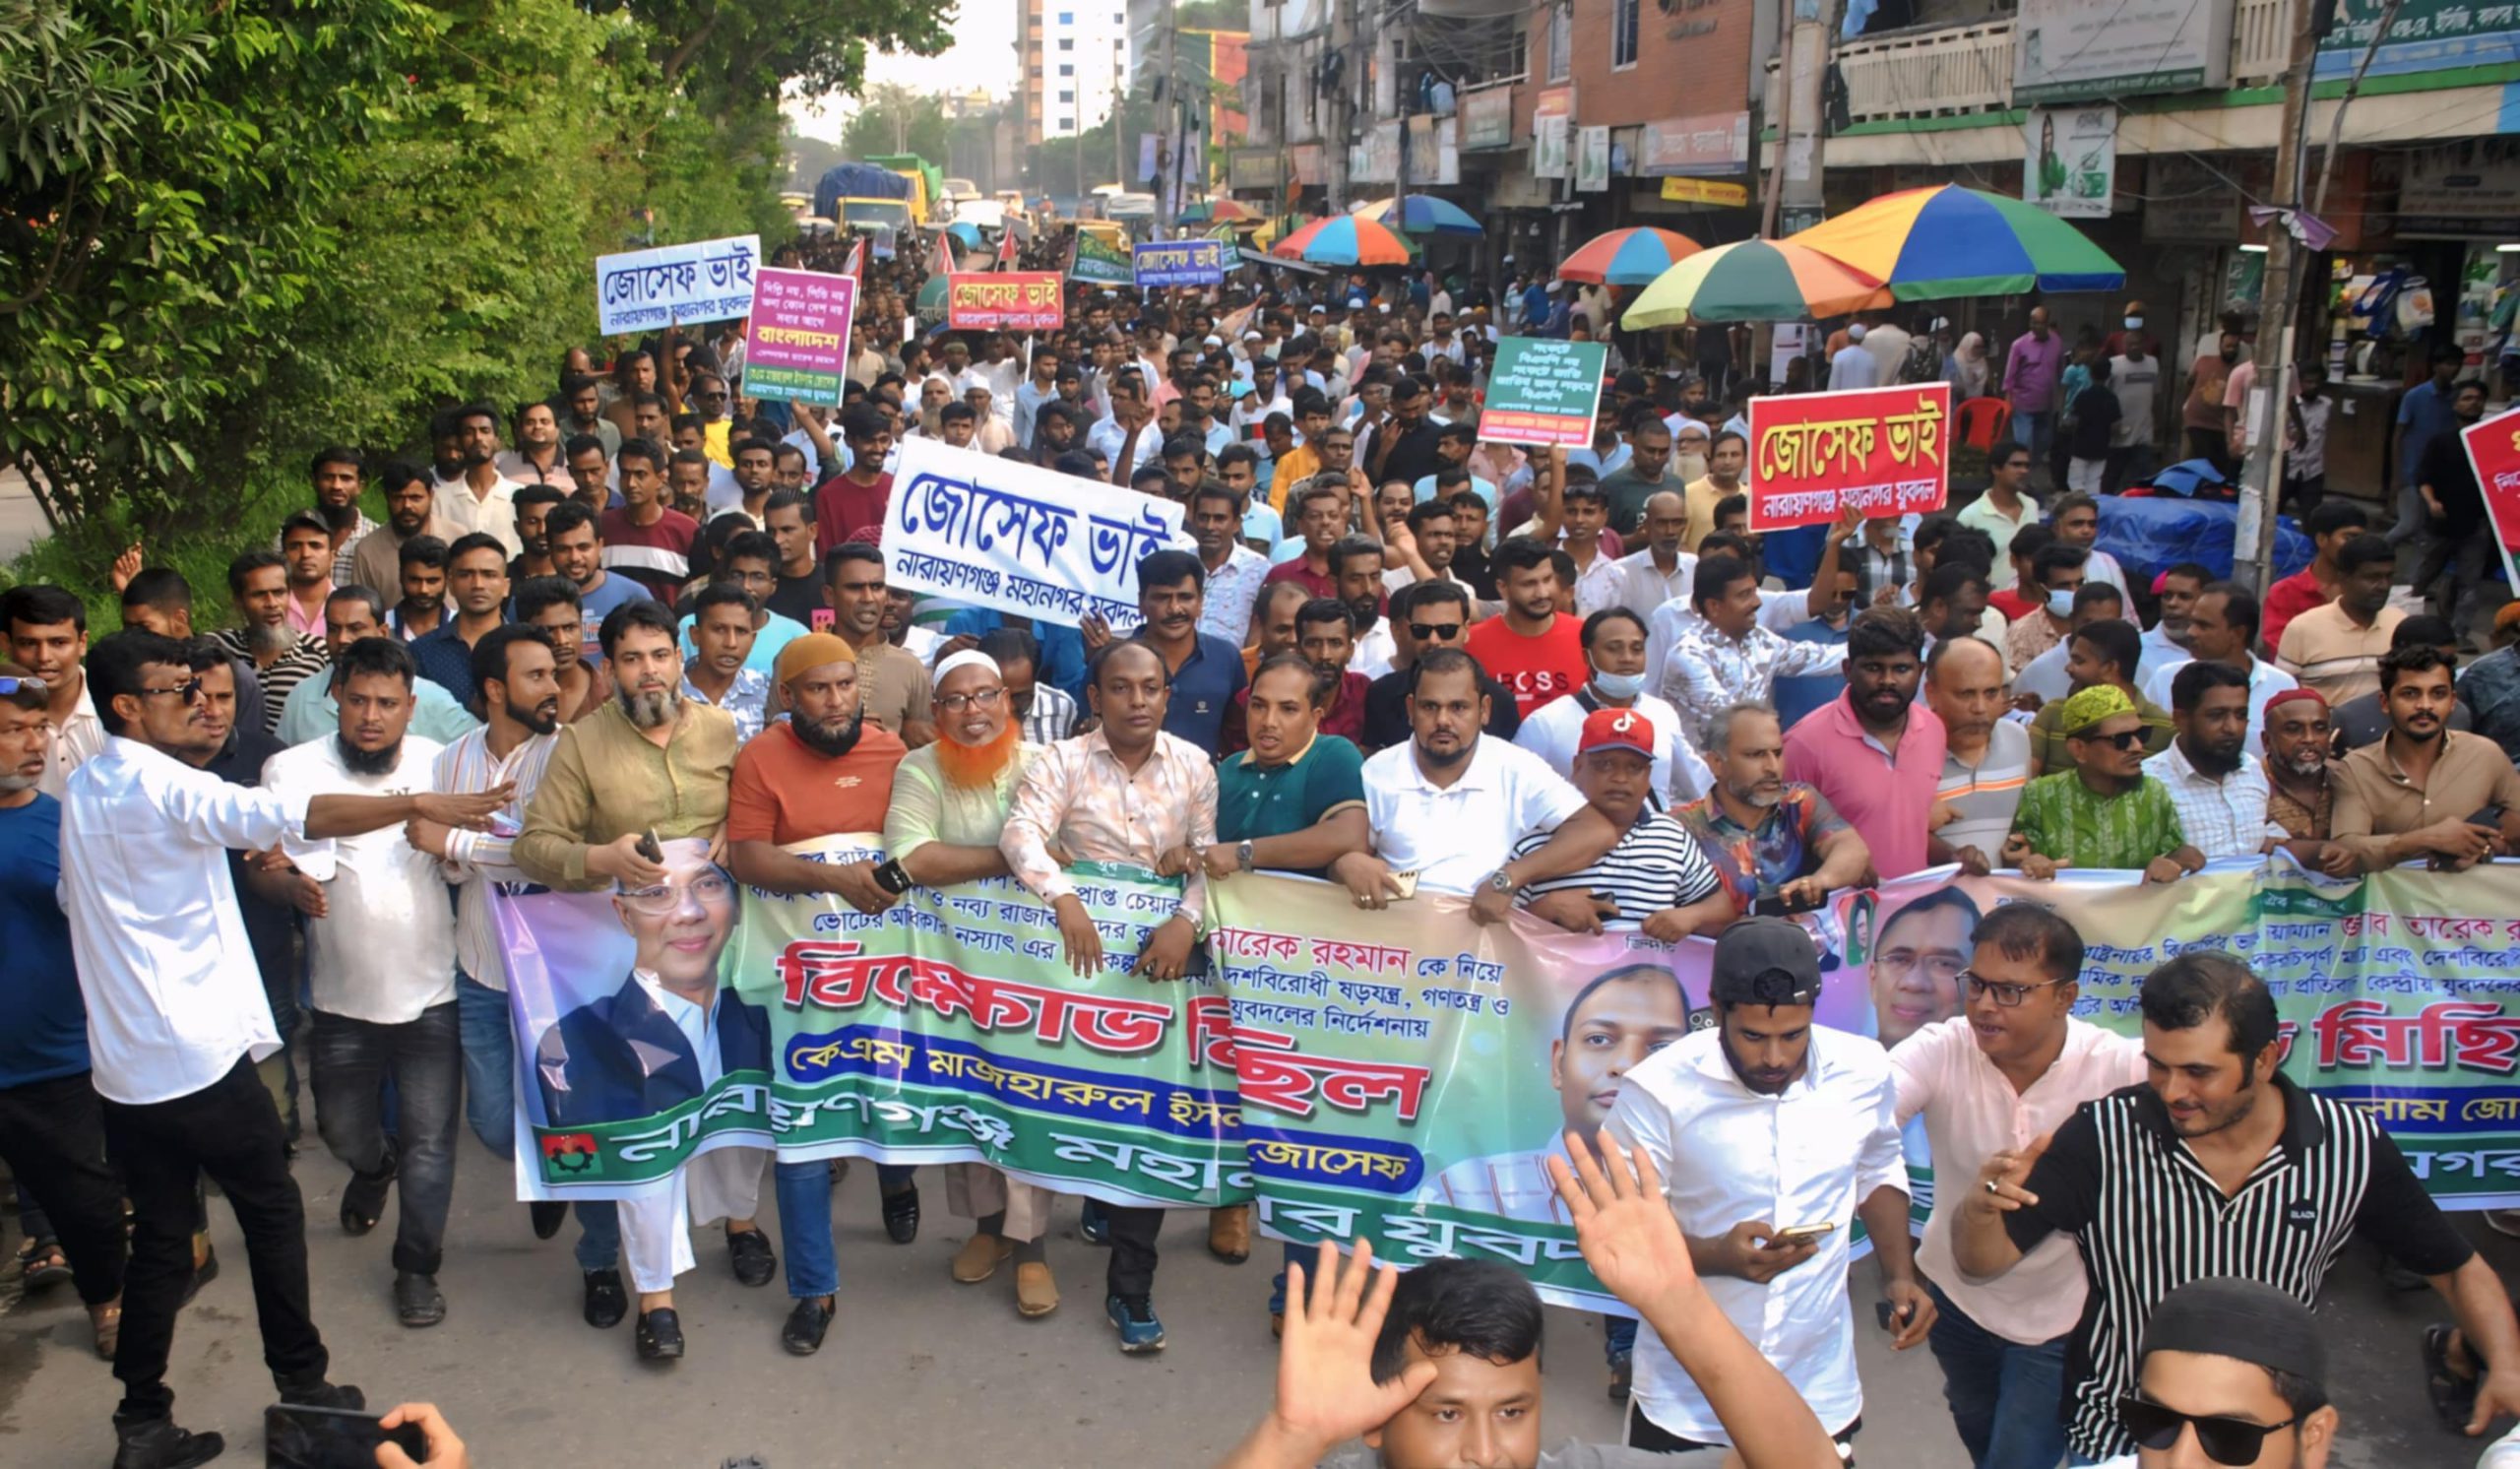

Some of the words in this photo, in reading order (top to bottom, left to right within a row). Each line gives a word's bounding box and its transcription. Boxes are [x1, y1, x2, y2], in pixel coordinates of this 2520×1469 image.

[604, 260, 697, 306] জোসেফ
[704, 241, 754, 289] ভাই
[1137, 249, 1188, 272] জোসেফ
[1193, 243, 1220, 269] ভাই
[609, 306, 666, 327] নারায়ণগঞ্জ
[669, 298, 716, 318] মহানগর
[954, 283, 1019, 308] জোসেফ
[1025, 277, 1058, 309] ভাই
[756, 326, 840, 351] বাংলাদেশ
[1758, 417, 1878, 482] জোসেফ
[1884, 392, 1944, 468] ভাই
[1762, 488, 1836, 519] নারায়ণগঞ্জ
[1839, 483, 1893, 510] মহানগর
[1896, 478, 1938, 512] যুবদল
[901, 473, 1077, 568] জোসেফ
[1089, 502, 1172, 588] ভাই
[896, 547, 1000, 598] নারায়ণগঞ্জ
[1005, 573, 1085, 614] মহানগর
[1496, 671, 1570, 693] BOSS
[952, 895, 991, 918] নব্য
[2402, 914, 2496, 940] তারেক
[813, 911, 884, 932] ভোটের
[955, 924, 1015, 954] নস্যাৎ
[1023, 939, 1058, 961] এর
[1311, 936, 1413, 977] রহমান
[1416, 956, 1449, 978] কে
[1457, 952, 1506, 985] নিয়ে
[775, 939, 1174, 1054] বিক্ষোভ
[1421, 988, 1483, 1013] গণতন্ত্র
[1490, 997, 1511, 1016] ও
[2366, 969, 2435, 998] কেন্দ্রীয়
[1230, 997, 1318, 1029] যুবদলের
[1325, 1005, 1431, 1040] নির্দেশনায়
[2311, 999, 2520, 1073] মিছি
[926, 1048, 1157, 1115] মাজহারুল
[608, 1083, 1016, 1162] নারায়ণগঞ্জ
